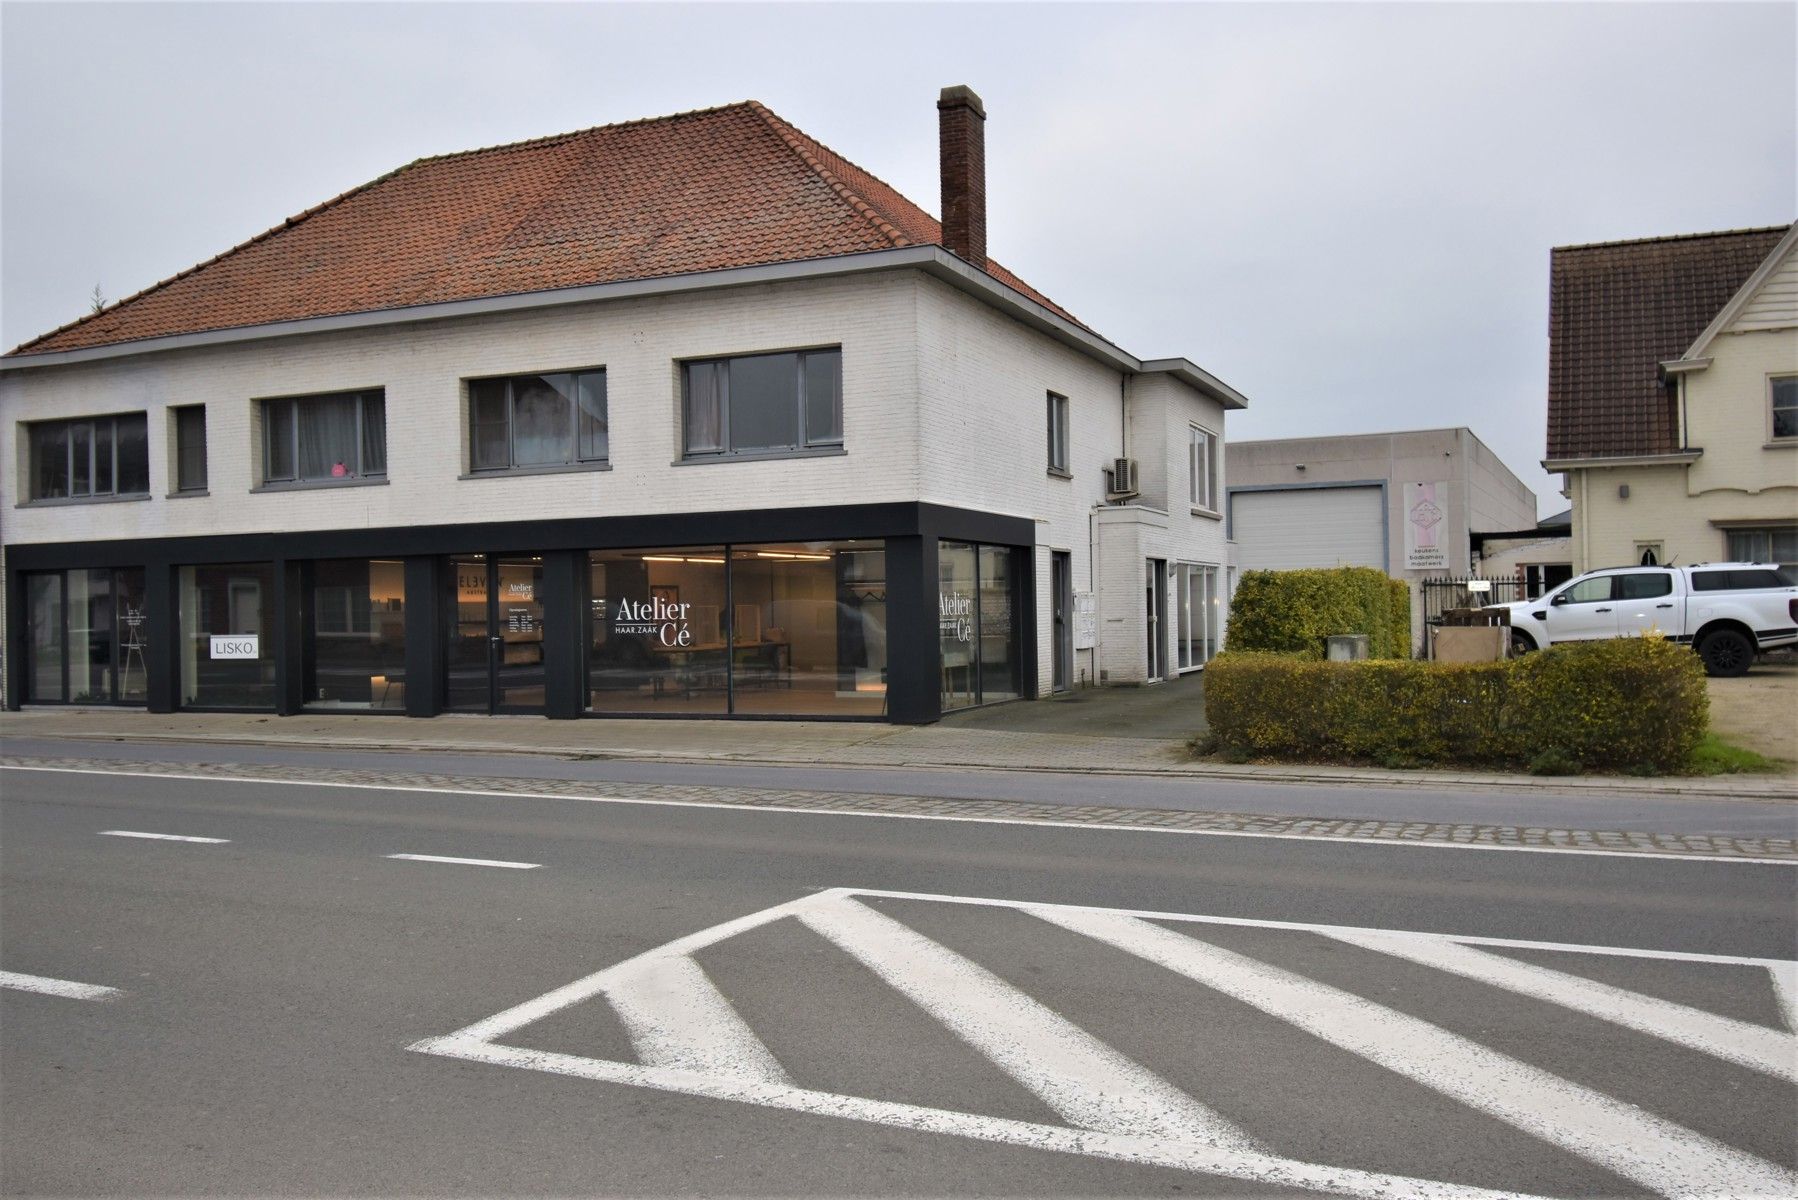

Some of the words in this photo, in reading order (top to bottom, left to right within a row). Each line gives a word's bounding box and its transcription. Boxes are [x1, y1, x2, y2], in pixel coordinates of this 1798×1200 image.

[508, 583, 533, 592] Atelier
[616, 597, 691, 620] Atelier
[939, 592, 970, 615] Atelier
[660, 622, 690, 647] Cé
[957, 617, 970, 642] Cé
